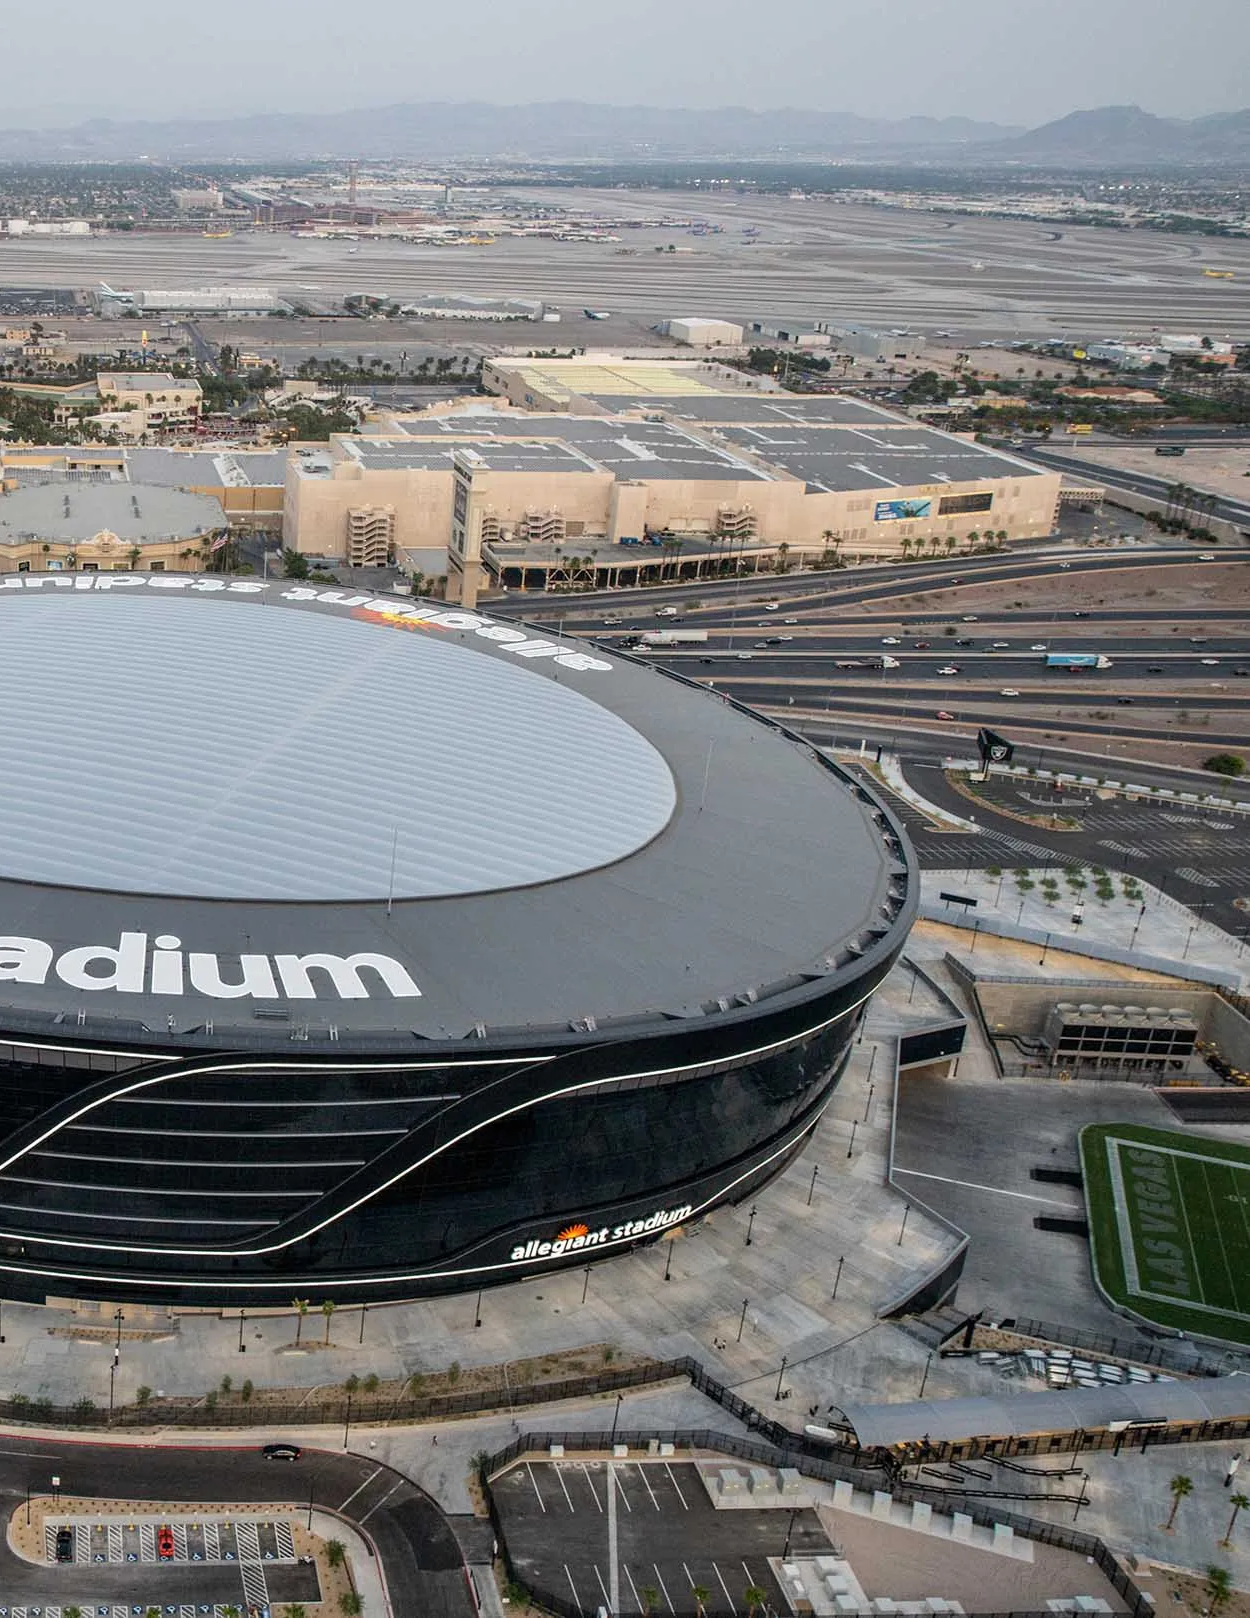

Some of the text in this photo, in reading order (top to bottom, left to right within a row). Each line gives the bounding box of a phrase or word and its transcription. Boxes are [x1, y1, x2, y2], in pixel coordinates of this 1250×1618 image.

[280, 587, 613, 671] allegiant
[510, 1205, 693, 1260] allegiant stadium
[1128, 1149, 1190, 1295] LAS VEGAS
